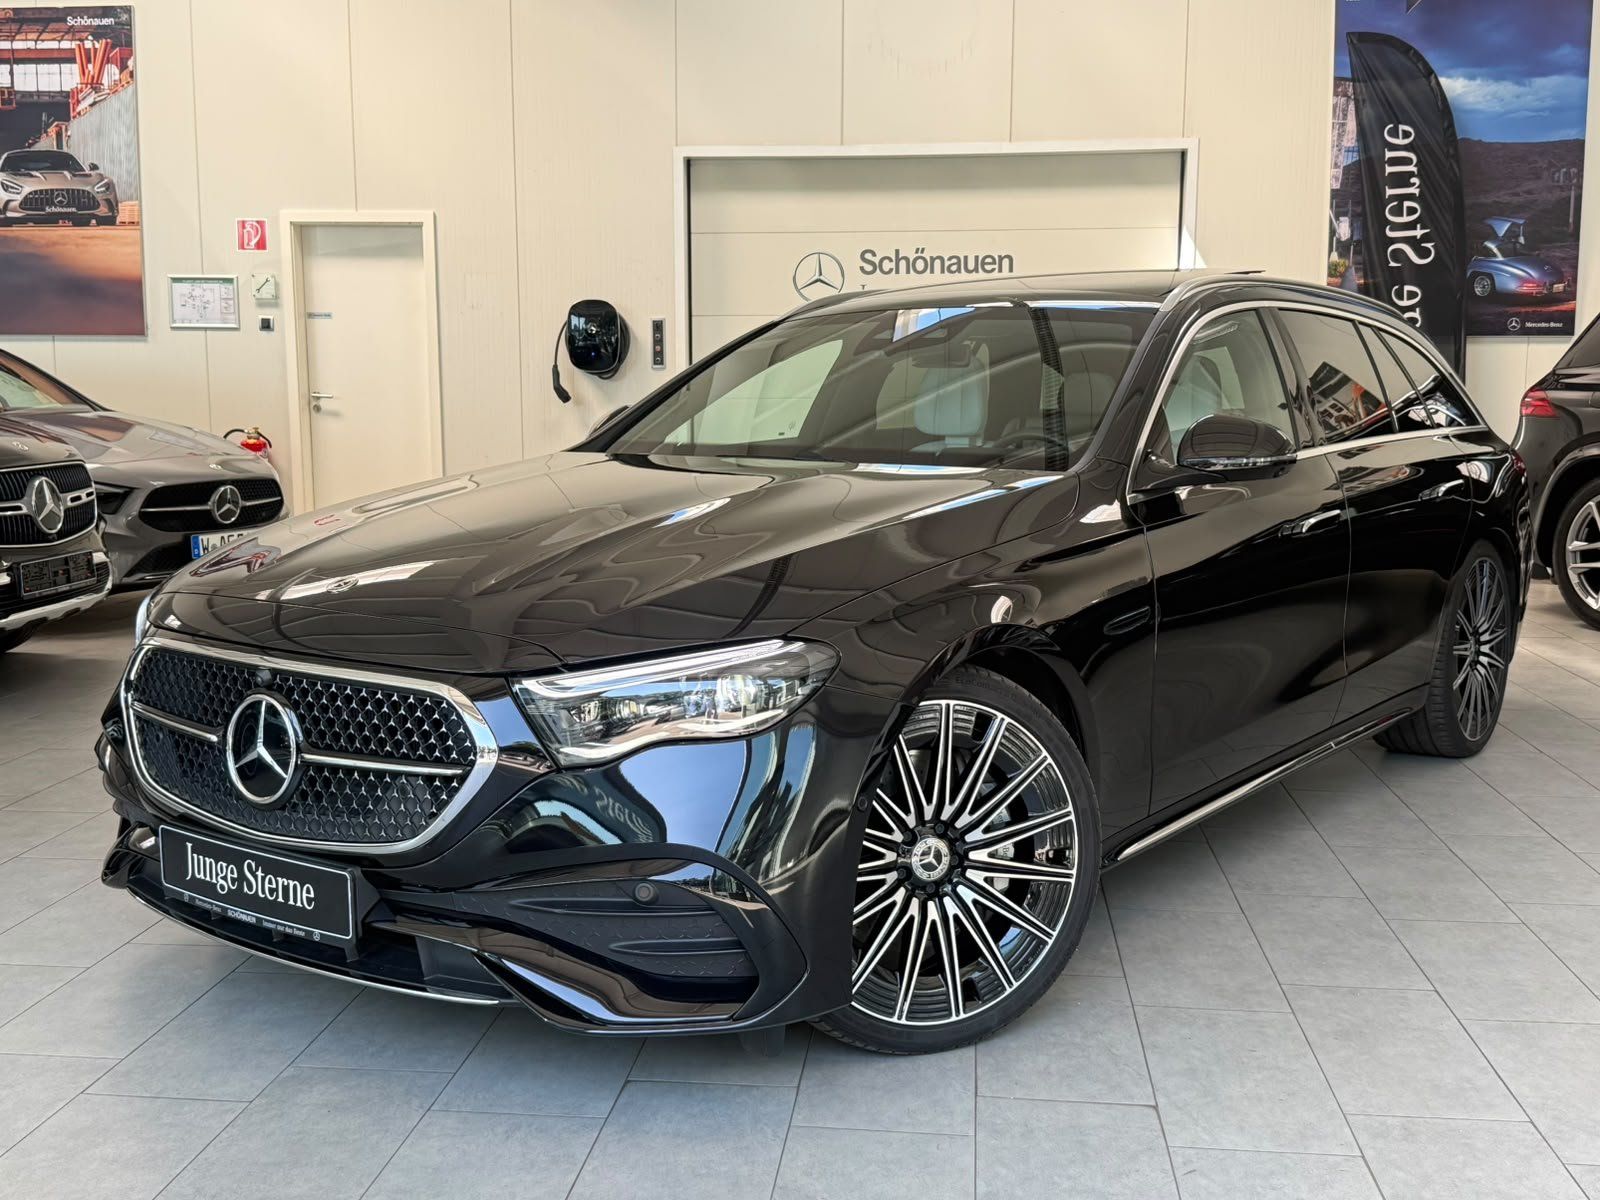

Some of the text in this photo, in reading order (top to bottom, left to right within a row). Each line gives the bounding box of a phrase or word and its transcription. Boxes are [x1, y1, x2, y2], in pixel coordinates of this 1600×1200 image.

[66, 15, 115, 26] Schönauen
[859, 247, 1014, 275] Schönauen
[200, 537, 210, 554] W
[185, 841, 315, 910] Junge Sterne
